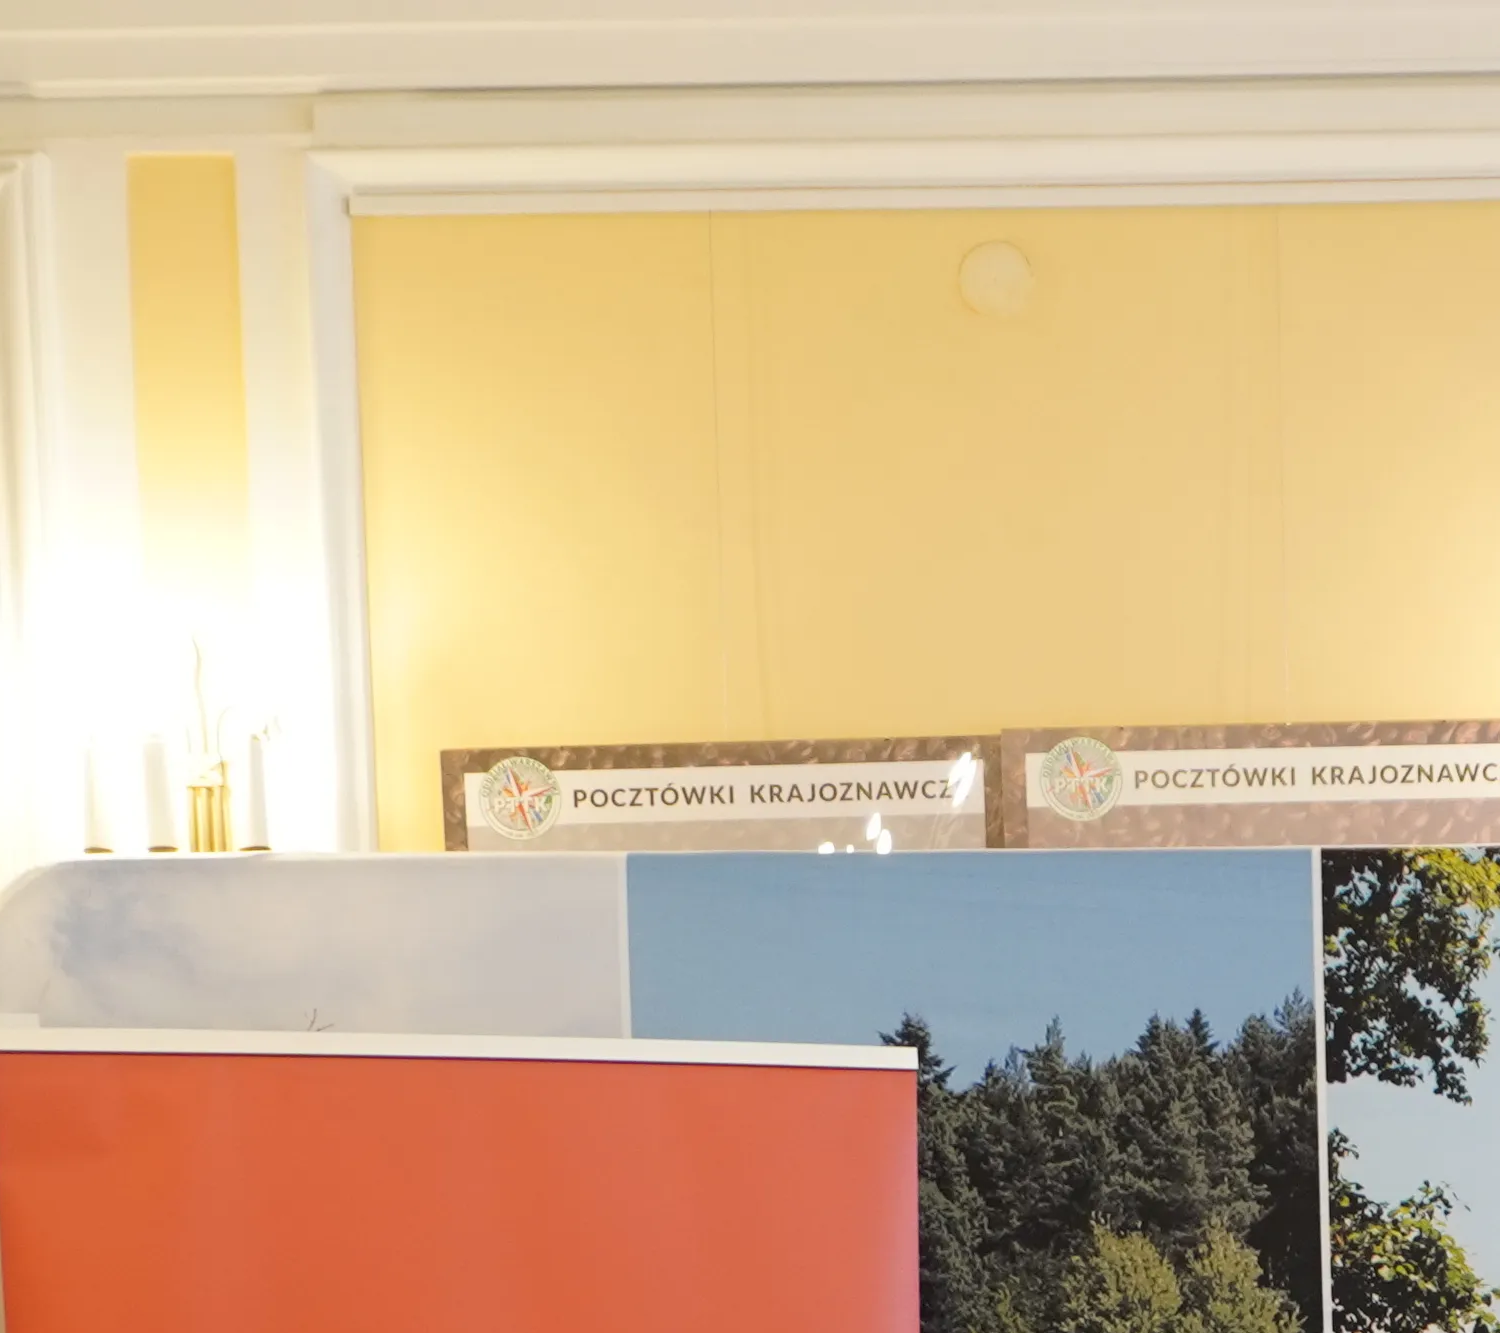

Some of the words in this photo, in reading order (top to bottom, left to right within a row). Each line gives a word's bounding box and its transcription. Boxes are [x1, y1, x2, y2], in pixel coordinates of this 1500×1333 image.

[1135, 764, 1296, 789] POCZTÓWKI
[573, 782, 735, 808] POCZTÓWKI
[750, 778, 968, 805] KRAJOZNAWCZ
